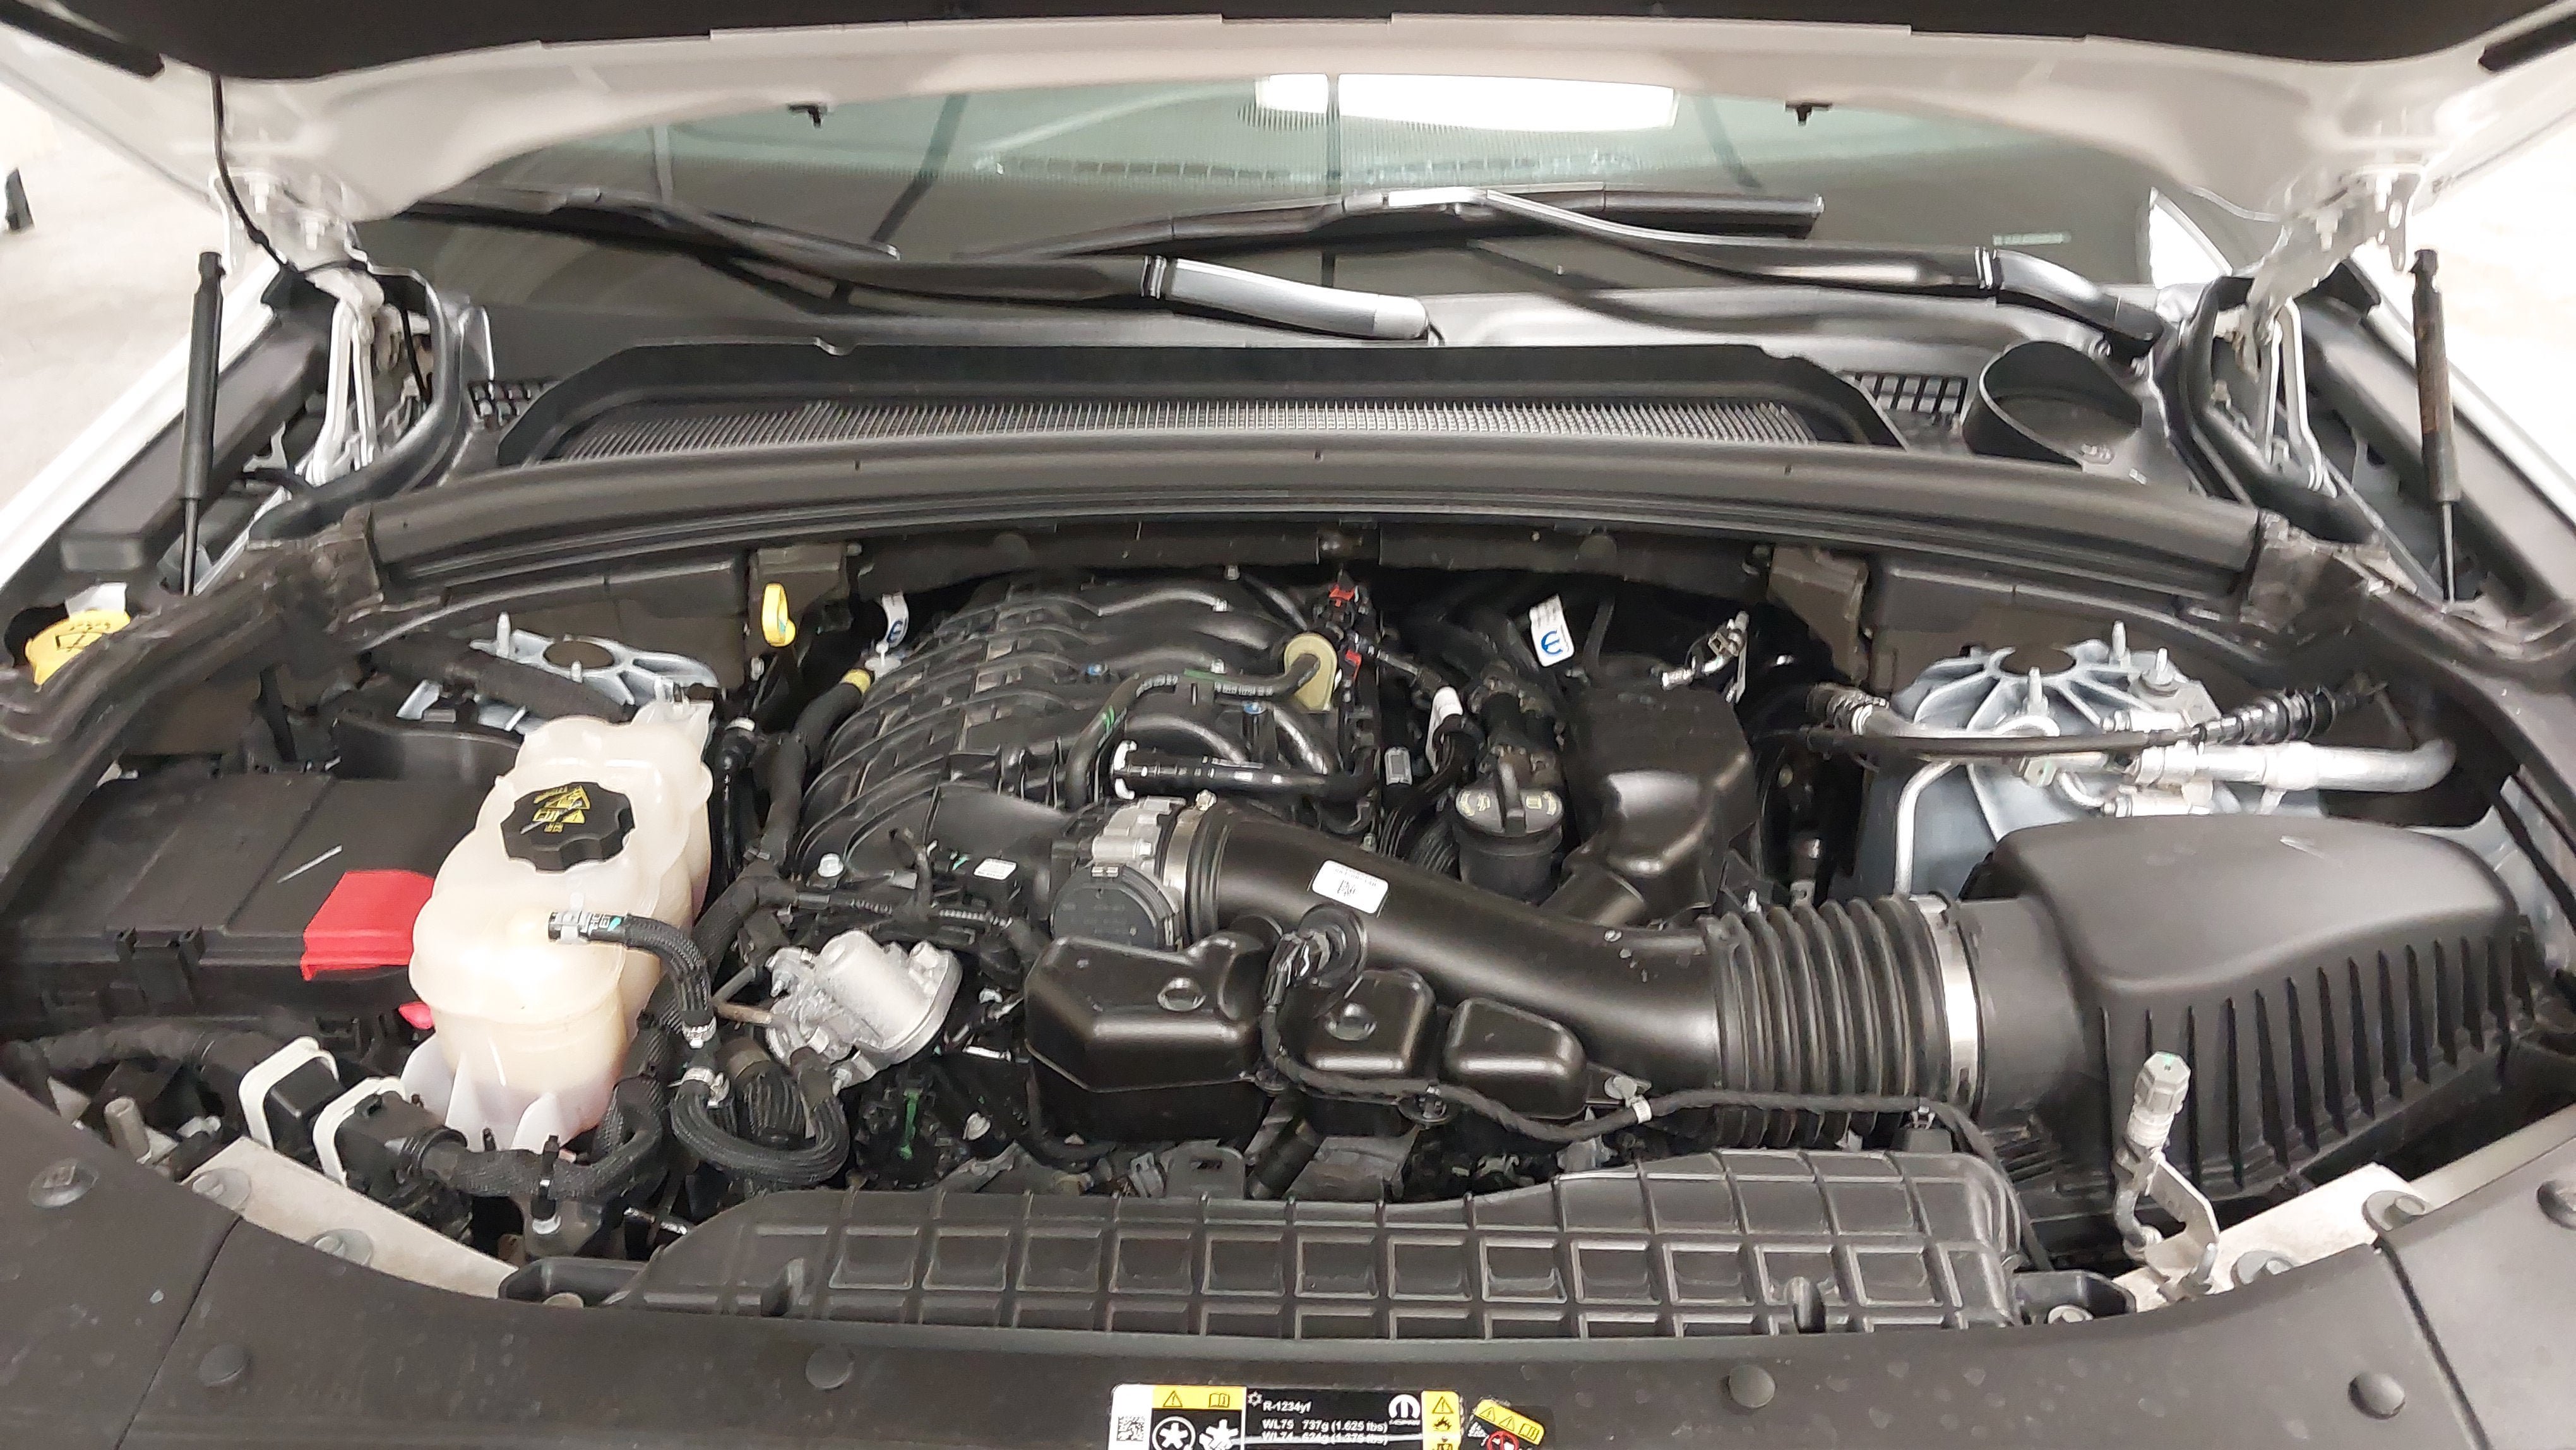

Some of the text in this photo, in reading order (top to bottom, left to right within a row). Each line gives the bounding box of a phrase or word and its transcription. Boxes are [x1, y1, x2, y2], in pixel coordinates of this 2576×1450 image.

[1261, 1418, 1294, 1430] WL75
[1301, 1419, 1329, 1432] 737g
[1331, 1420, 1364, 1434] (1.625
[1366, 1421, 1388, 1434] lbs)
